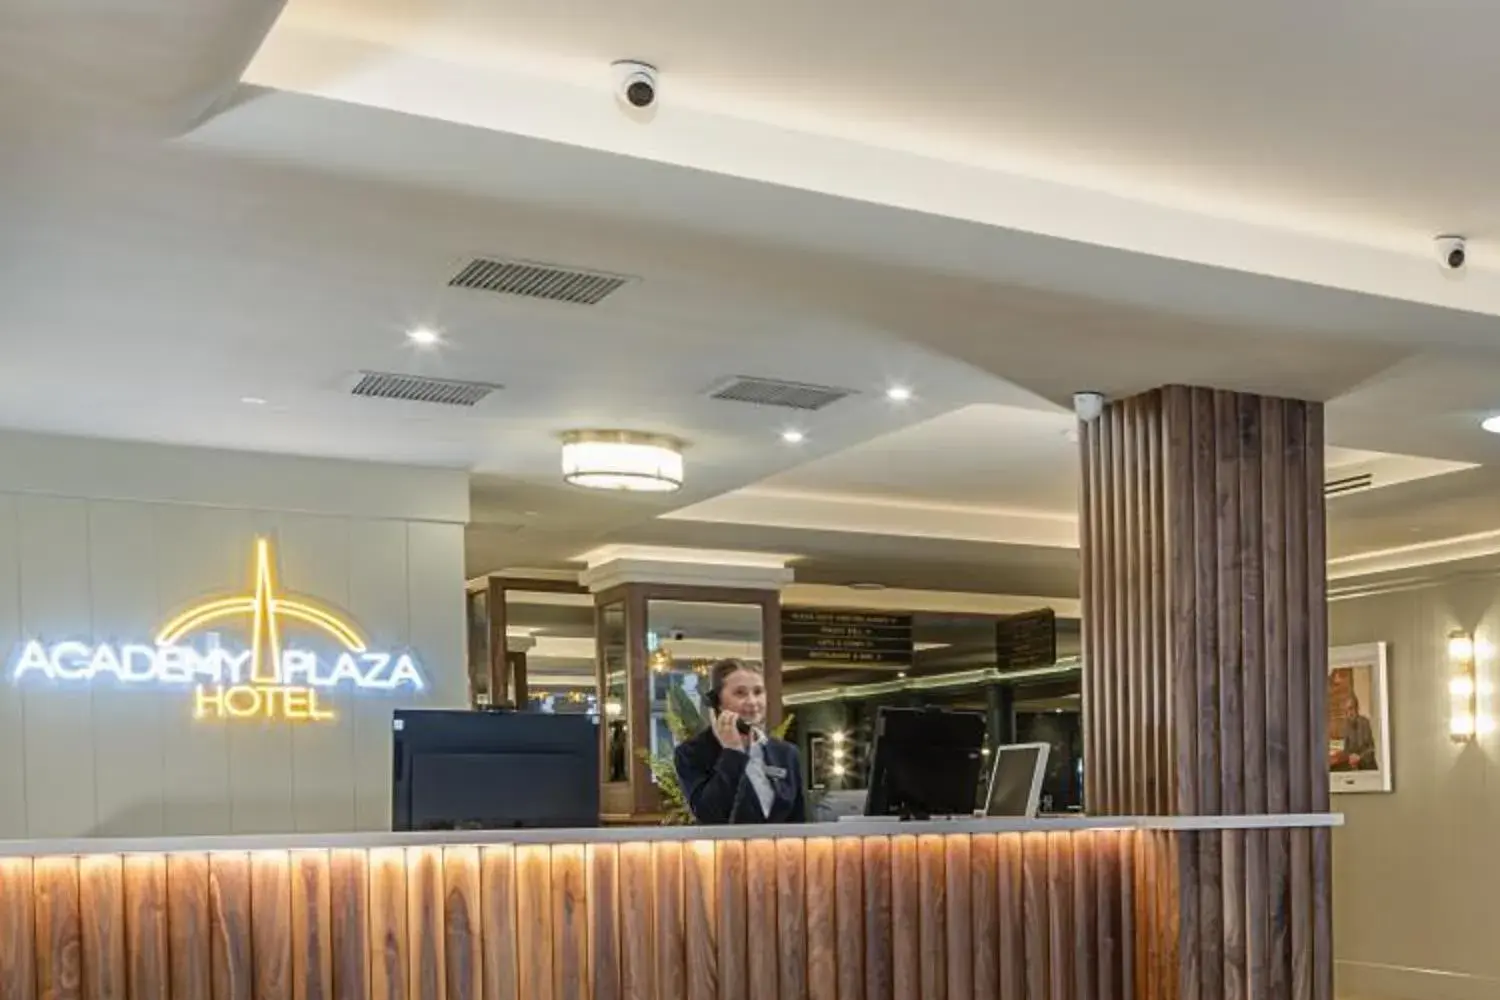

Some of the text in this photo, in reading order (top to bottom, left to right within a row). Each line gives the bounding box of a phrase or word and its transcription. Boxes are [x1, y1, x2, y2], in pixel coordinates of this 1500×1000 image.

[13, 638, 424, 690] ACADEMY PLAZA
[196, 685, 335, 719] HOTEL
